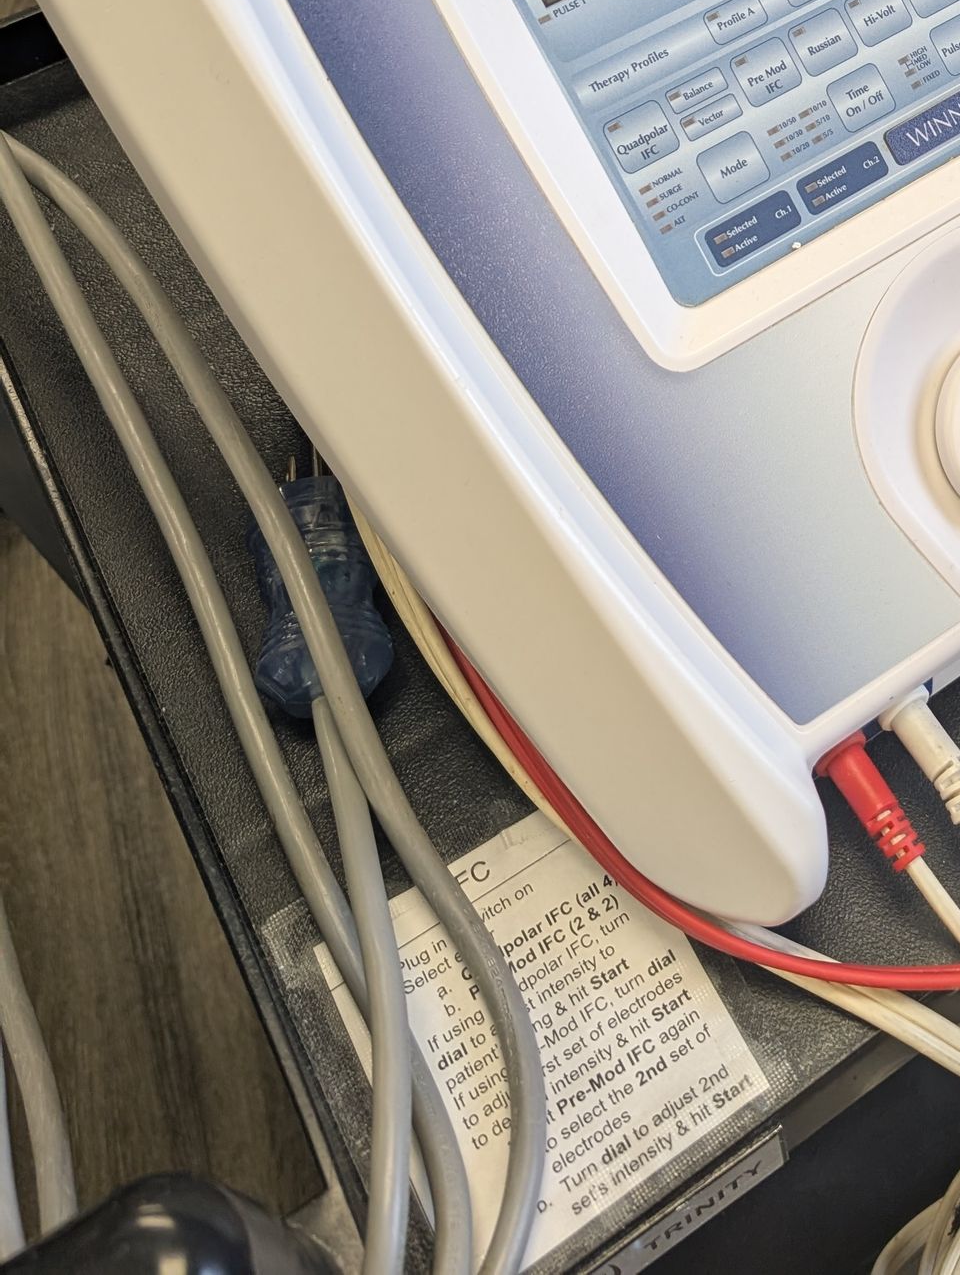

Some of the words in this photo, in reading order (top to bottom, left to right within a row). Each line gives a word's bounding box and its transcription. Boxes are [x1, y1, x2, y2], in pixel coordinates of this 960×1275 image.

[552, 0, 581, 18] PULSE
[716, 12, 746, 31] Profile
[747, 7, 756, 16] A
[863, 4, 897, 27] Hi-Volt
[807, 34, 842, 56] Russian
[910, 45, 928, 59] HIGH
[588, 68, 630, 93] Therapy
[630, 48, 669, 72] Profiles
[913, 54, 928, 64] MED
[916, 60, 932, 71] LOW
[747, 73, 765, 87] Pre
[765, 60, 787, 80] Mod
[922, 69, 941, 84] FIXED
[682, 80, 713, 101] Balance
[765, 79, 784, 94] IFC
[845, 84, 870, 101] Time
[809, 100, 828, 114] 10/10
[845, 104, 861, 118] On
[868, 90, 885, 106] Off
[697, 109, 724, 127] Vector
[616, 124, 669, 155] Quadpolar
[640, 144, 660, 160] IFC
[651, 167, 684, 188] NORMAL
[720, 158, 748, 179] Mode
[816, 165, 847, 188] Selected
[658, 183, 683, 201] SURGE
[666, 191, 700, 214] CO-CONT
[825, 184, 847, 201] Active
[673, 215, 686, 227] ALT
[726, 215, 758, 238] Selected
[734, 234, 758, 252] Active
[431, 938, 448, 954] in
[481, 897, 512, 923] itch
[514, 882, 534, 901] on
[437, 987, 453, 1000] a.
[545, 901, 573, 926] IFC
[575, 882, 601, 908] (all
[445, 1002, 462, 1017] b.
[538, 929, 567, 954] IFC
[569, 916, 586, 936] (2
[588, 907, 600, 922] &
[602, 894, 619, 912] 2)
[403, 960, 452, 995] Select
[427, 1037, 439, 1053] If
[442, 1009, 485, 1041] using
[518, 955, 563, 993] dpolar
[566, 933, 599, 960] IFC,
[600, 910, 630, 936] turn
[437, 1043, 468, 1071] dial
[470, 1033, 486, 1049] to
[536, 955, 598, 1004] intensity
[599, 944, 616, 961] to
[445, 1044, 499, 1094] patient'
[554, 1001, 568, 1016] &
[568, 984, 590, 1006] hit
[590, 957, 630, 991] Start
[452, 1094, 467, 1111] If
[470, 1067, 508, 1101] using
[540, 1016, 578, 1053] -Mod
[579, 996, 614, 1023] IFC,
[614, 974, 645, 999] turn
[647, 949, 677, 976] dial
[462, 1111, 479, 1130] to
[484, 1090, 512, 1117] adj
[541, 1055, 562, 1076] rst
[563, 1035, 588, 1061] set
[590, 1021, 605, 1041] of
[607, 972, 683, 1029] electrodes
[556, 1059, 626, 1115] Pre-Mod
[626, 1038, 656, 1067] IFC
[658, 1009, 701, 1045] again
[471, 1132, 489, 1150] to
[549, 1044, 612, 1094] intensity
[615, 1033, 629, 1048] &
[629, 1017, 651, 1038] hit
[651, 988, 692, 1022] Start
[561, 1099, 608, 1140] select
[608, 1082, 634, 1106] the
[635, 1056, 668, 1086] 2nd
[669, 1037, 695, 1062] set
[696, 1023, 712, 1043] of
[559, 1162, 598, 1193] Turn
[601, 1134, 632, 1165] dial
[632, 1123, 650, 1141] to
[652, 1085, 698, 1130] adjust
[698, 1064, 729, 1092] 2nd
[552, 1109, 632, 1174] electrodes
[571, 1182, 609, 1216] set's
[611, 1131, 674, 1186] intensity
[676, 1119, 691, 1137] &
[690, 1105, 713, 1126] hit
[712, 1074, 754, 1110] Start
[644, 1160, 763, 1250] TRINITY
